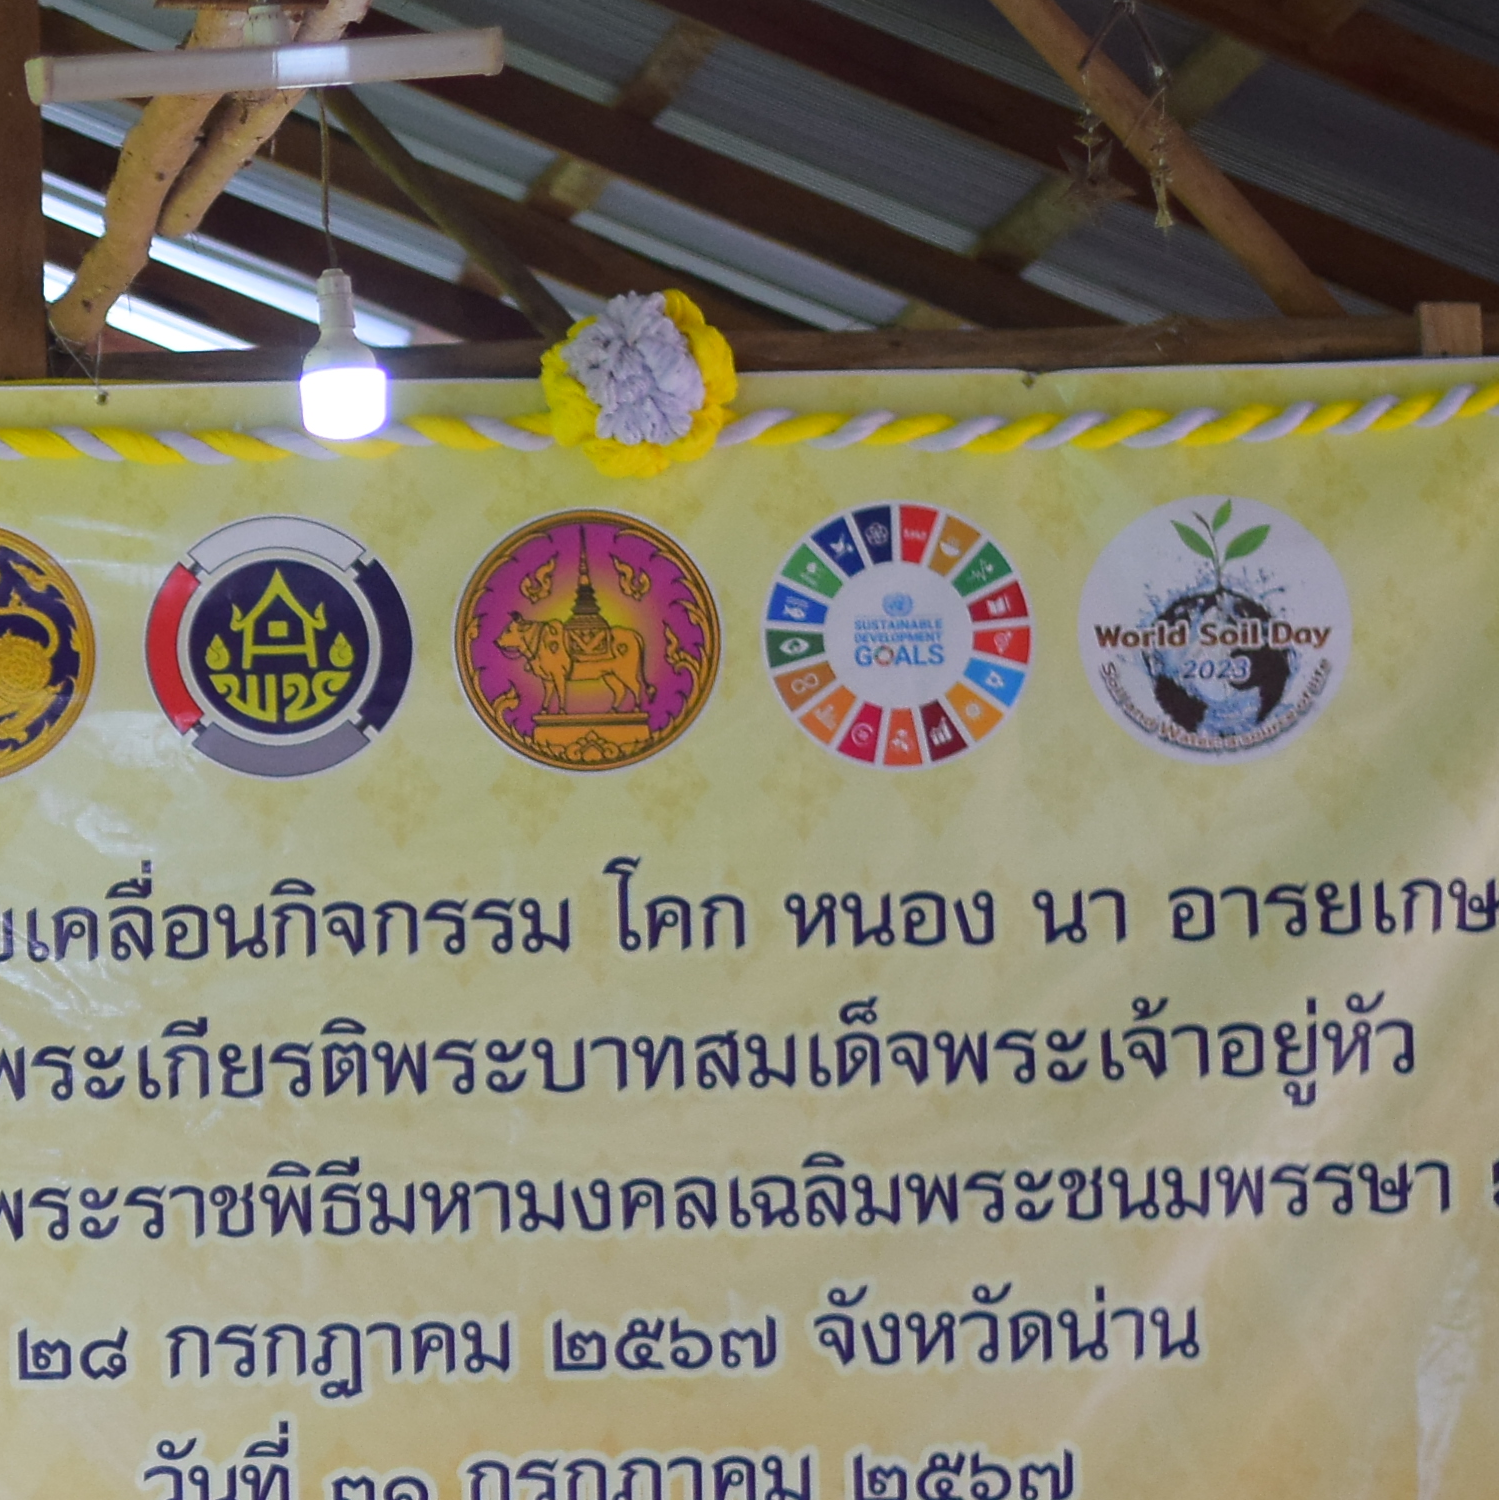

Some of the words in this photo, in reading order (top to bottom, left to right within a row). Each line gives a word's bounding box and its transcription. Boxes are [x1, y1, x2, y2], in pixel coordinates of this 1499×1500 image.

[853, 618, 943, 631] SUSTAINABLE
[1094, 619, 1187, 647] World
[1200, 620, 1259, 647] Soil
[1271, 621, 1331, 648] Day
[853, 632, 942, 643] DEVELOPMENT
[854, 643, 945, 667] GOALS
[1182, 657, 1249, 681] 2023
[603, 856, 746, 951] โคก
[784, 890, 995, 948] หนอง
[1033, 889, 1127, 944] นา
[18, 1326, 129, 1381] ๒๘
[166, 1320, 510, 1399] กรกฎาคม
[553, 1315, 777, 1372] ๒๕๖๗
[814, 1283, 1200, 1366] จังหวัดน่าน
